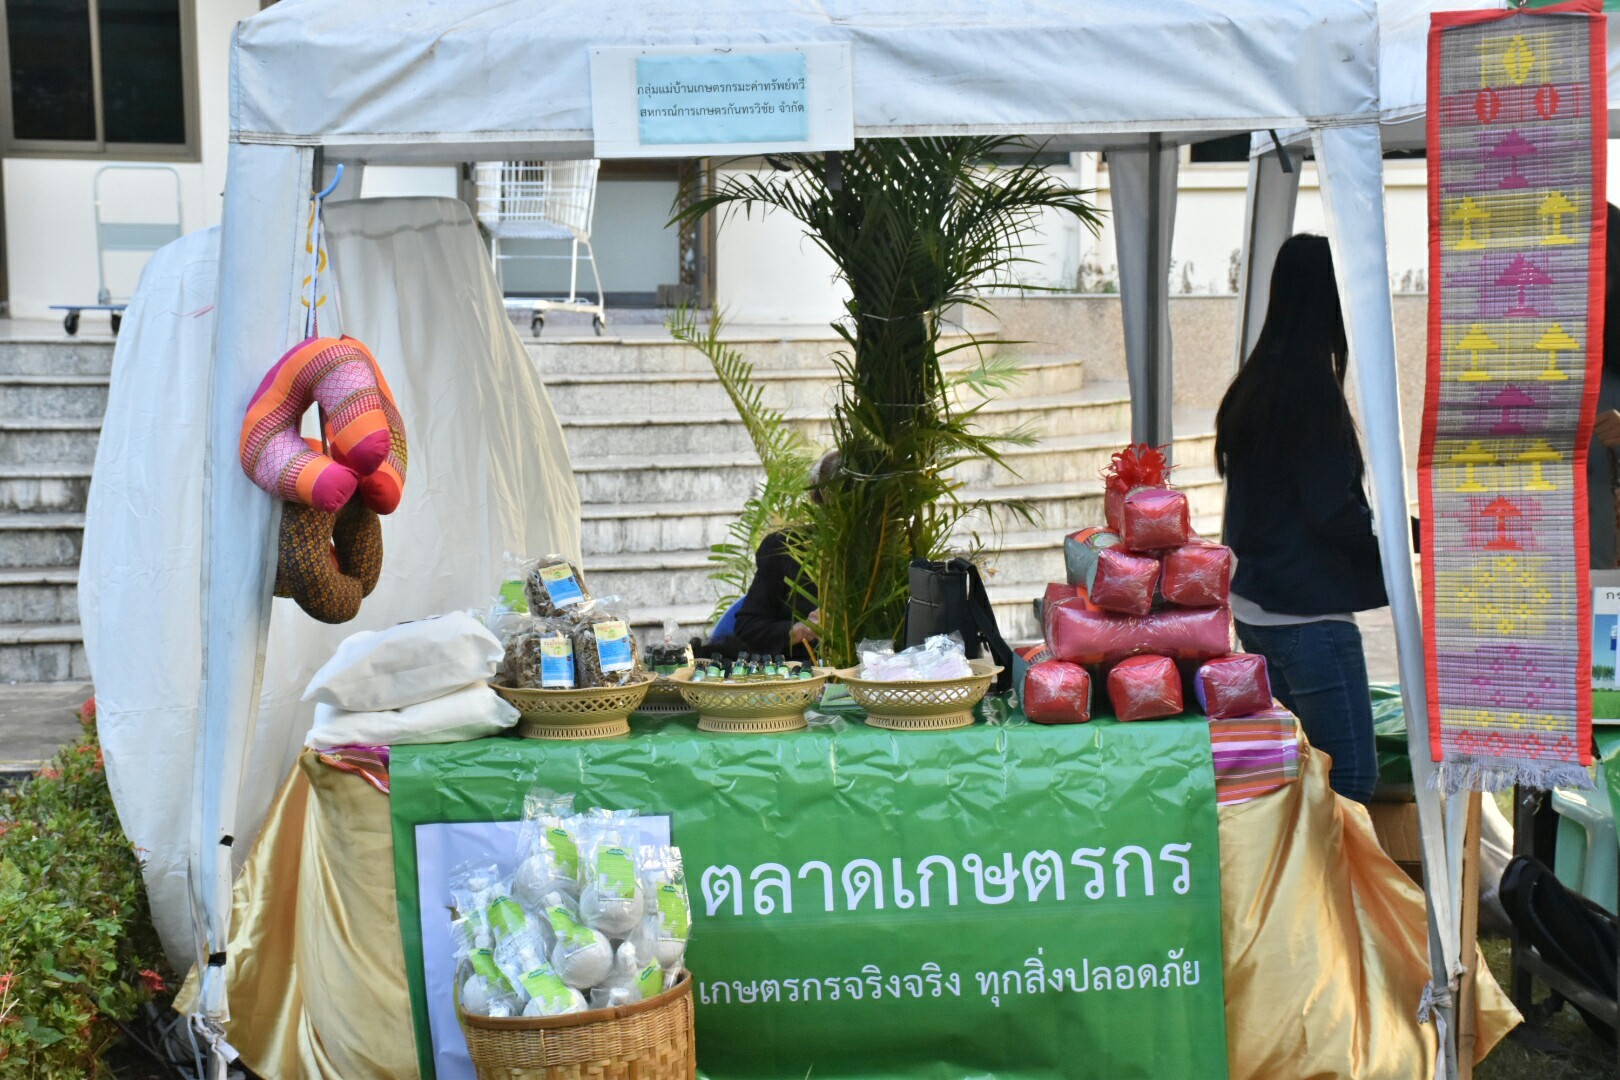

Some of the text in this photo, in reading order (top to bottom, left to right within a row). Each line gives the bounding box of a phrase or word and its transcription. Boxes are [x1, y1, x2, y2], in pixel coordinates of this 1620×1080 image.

[640, 100, 805, 118] สหกรณ์การเกษตรกันทรวิชัย จำกัด
[699, 841, 1193, 917] ตลาดเกษตรกร
[699, 947, 1200, 1007] เกษตรกรจริงจริง ทุกสิ่งปลอดภัย
